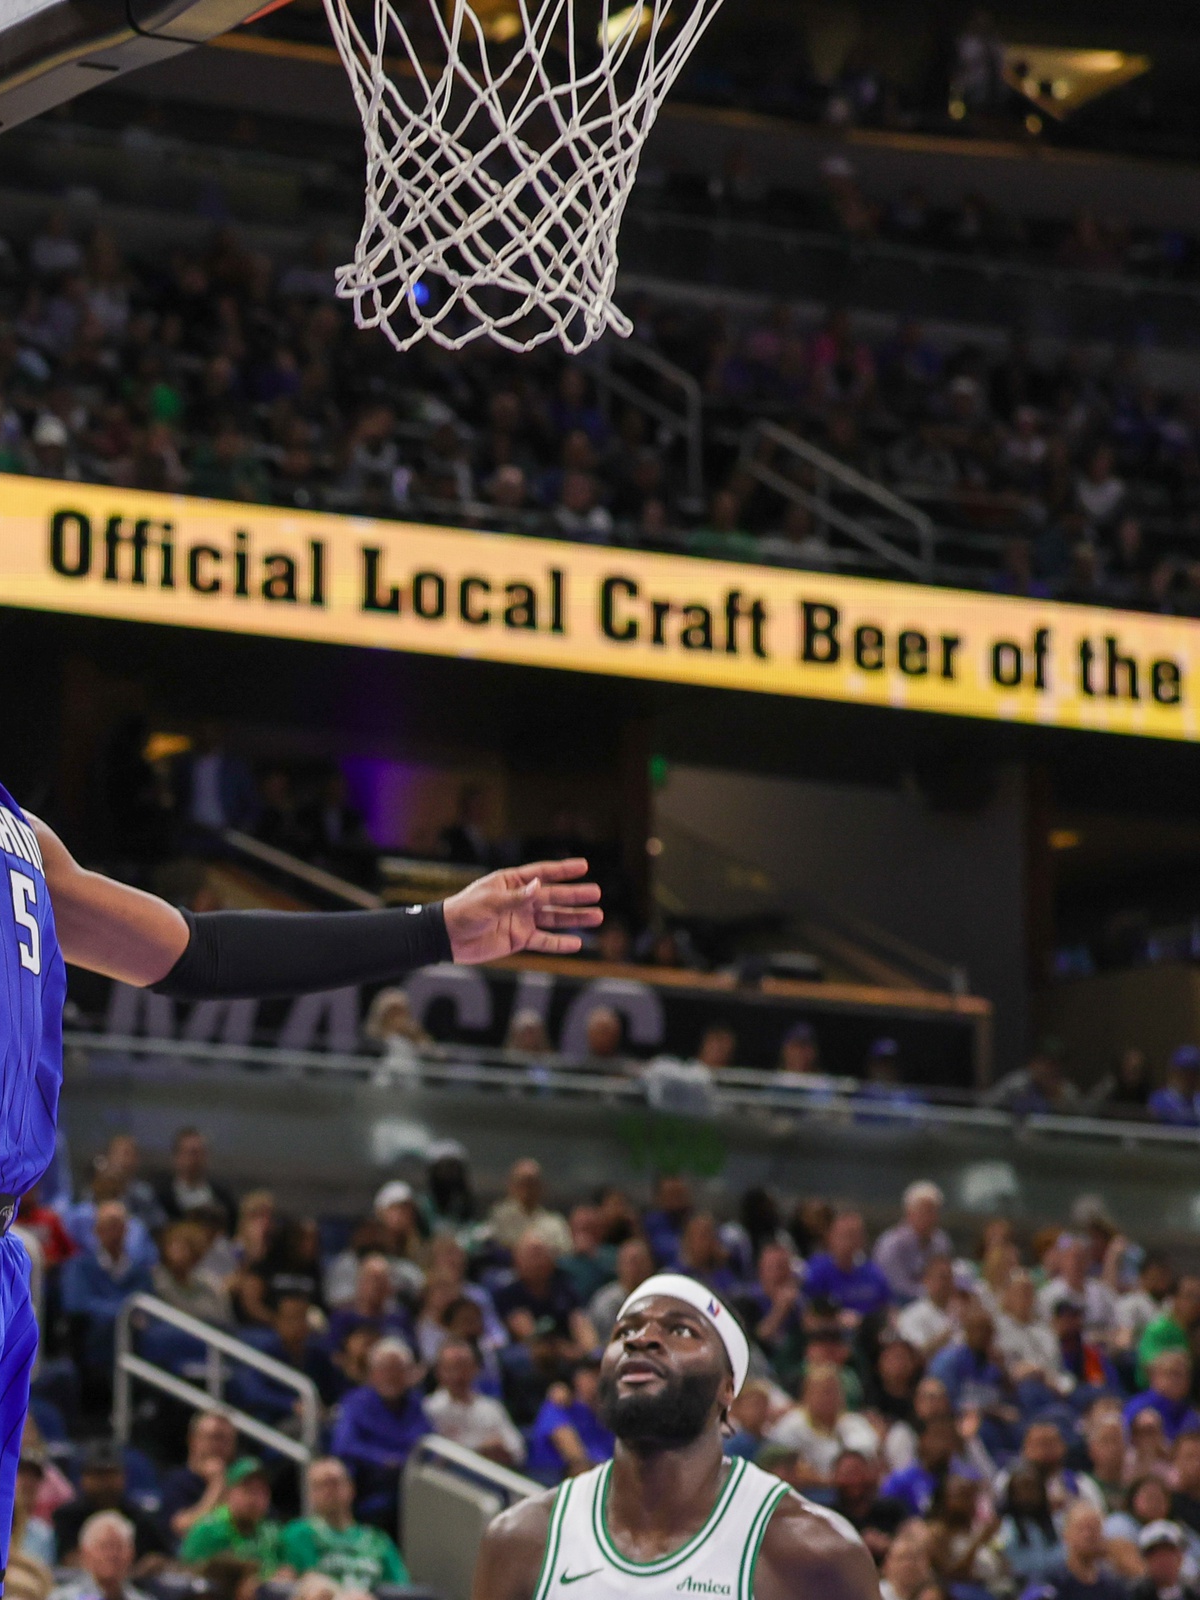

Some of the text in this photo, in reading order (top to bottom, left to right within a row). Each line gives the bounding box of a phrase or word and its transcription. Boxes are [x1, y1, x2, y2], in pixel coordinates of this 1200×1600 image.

[50, 510, 1181, 705] Official Local Craft Beer of the
[9, 868, 41, 976] 5
[676, 1576, 731, 1595] Amica
